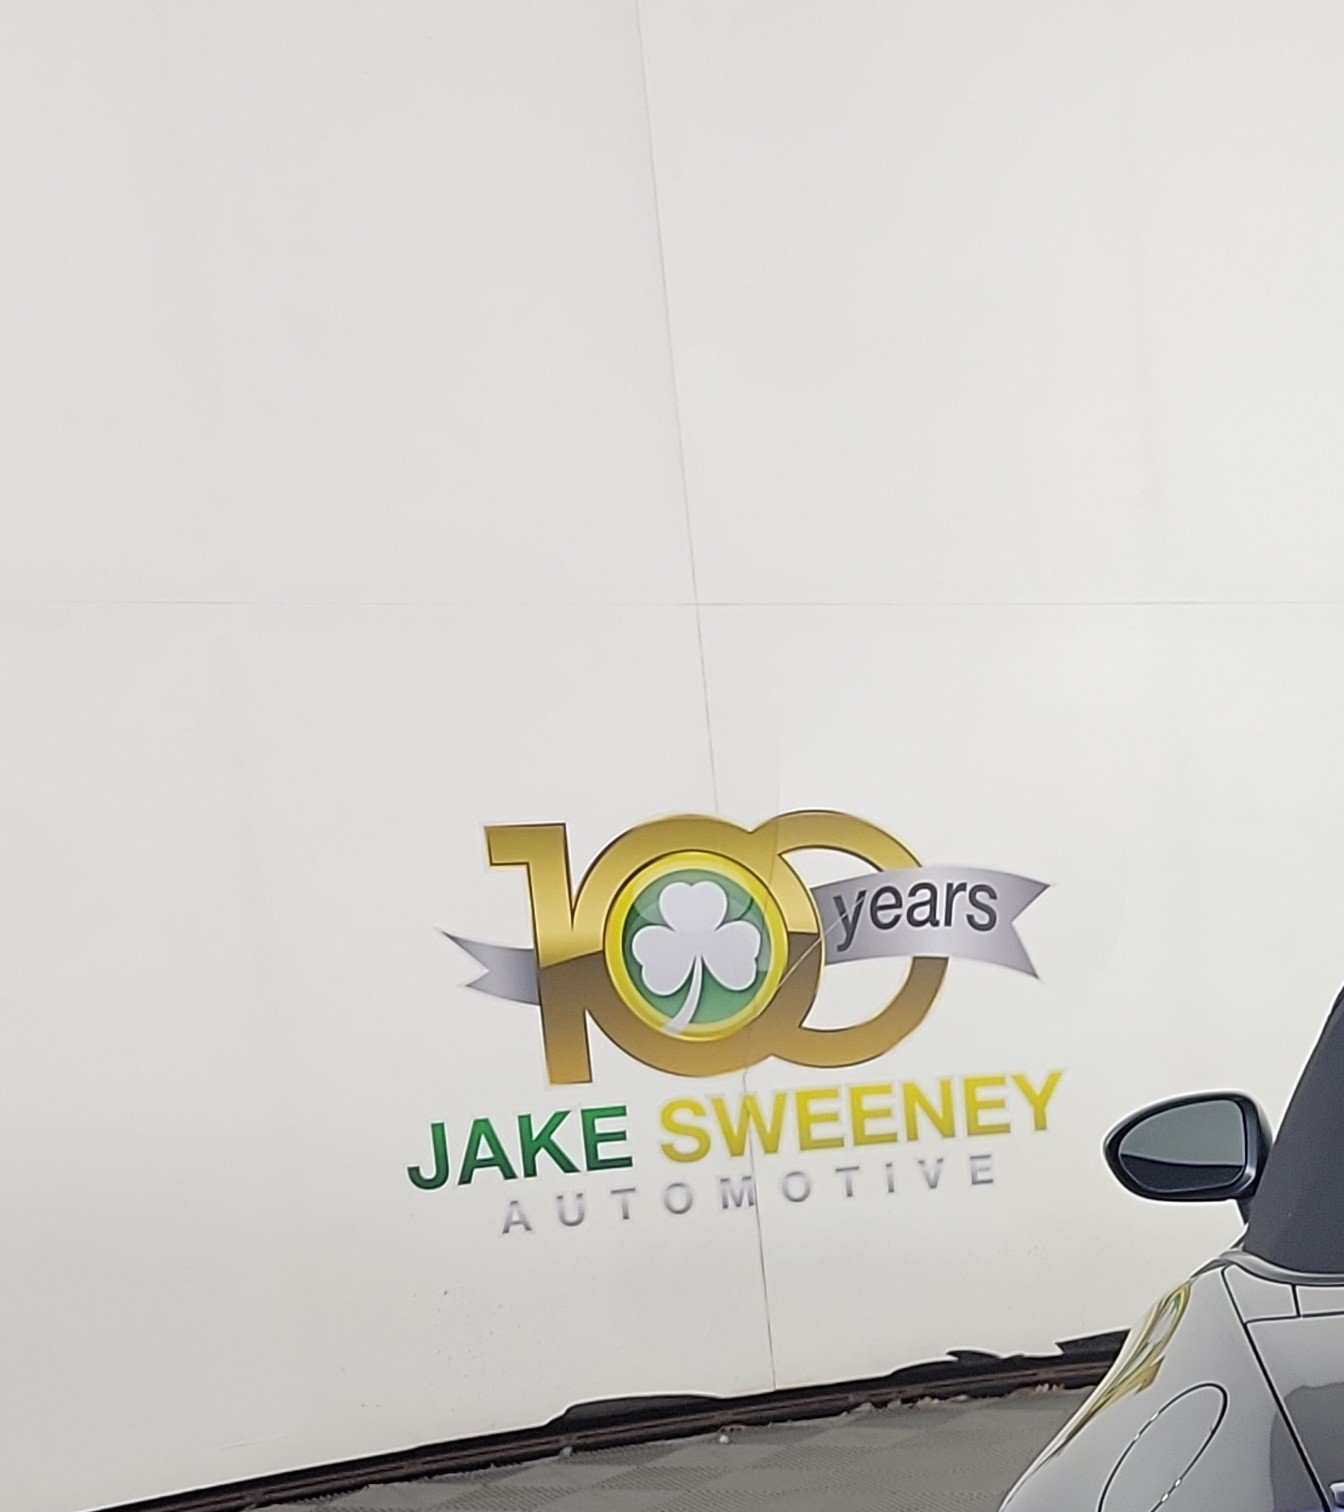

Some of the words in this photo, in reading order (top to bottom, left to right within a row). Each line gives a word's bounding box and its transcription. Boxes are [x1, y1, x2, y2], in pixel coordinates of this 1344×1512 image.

[485, 809, 948, 1084] 100
[833, 880, 998, 952] years
[407, 1104, 633, 1190] JAKE
[659, 1070, 1064, 1163] SWEENEY
[502, 1154, 995, 1234] AUTOMOTIVE
